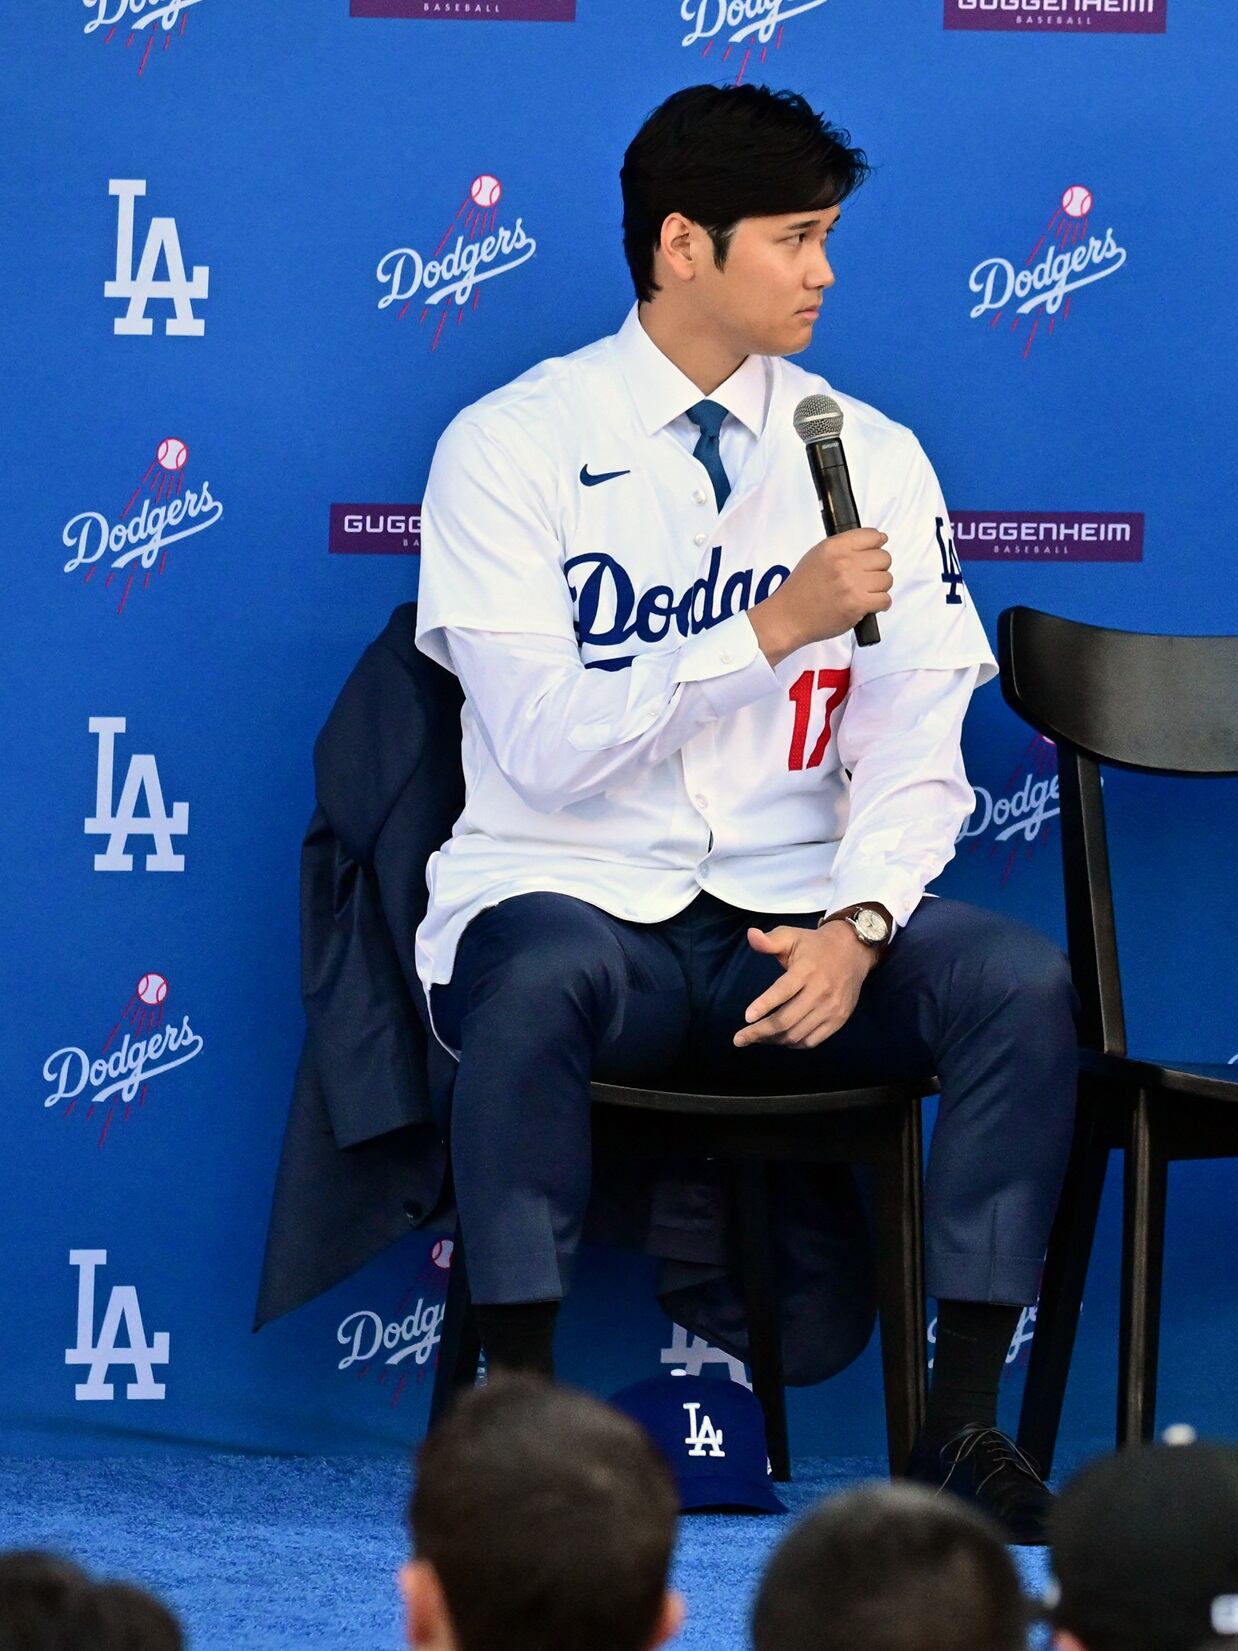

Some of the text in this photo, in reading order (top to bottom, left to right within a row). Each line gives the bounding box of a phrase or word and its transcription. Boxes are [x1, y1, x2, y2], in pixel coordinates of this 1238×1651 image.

[423, 2, 500, 13] BASEBALL
[1016, 15, 1092, 25] BASEBALL
[105, 179, 209, 337] LA
[376, 217, 537, 310] Dodgers
[969, 227, 1127, 319] Dodgers
[62, 481, 223, 574] Dodgers
[950, 522, 1131, 541] UGGENHEIM
[993, 545, 1070, 555] BASEBALL
[788, 668, 852, 771] 17
[85, 716, 190, 872] LA
[43, 1015, 204, 1108] Dodgers
[65, 1249, 170, 1400] LA
[337, 1298, 446, 1370] Dodg
[682, 1402, 726, 1457] LA
